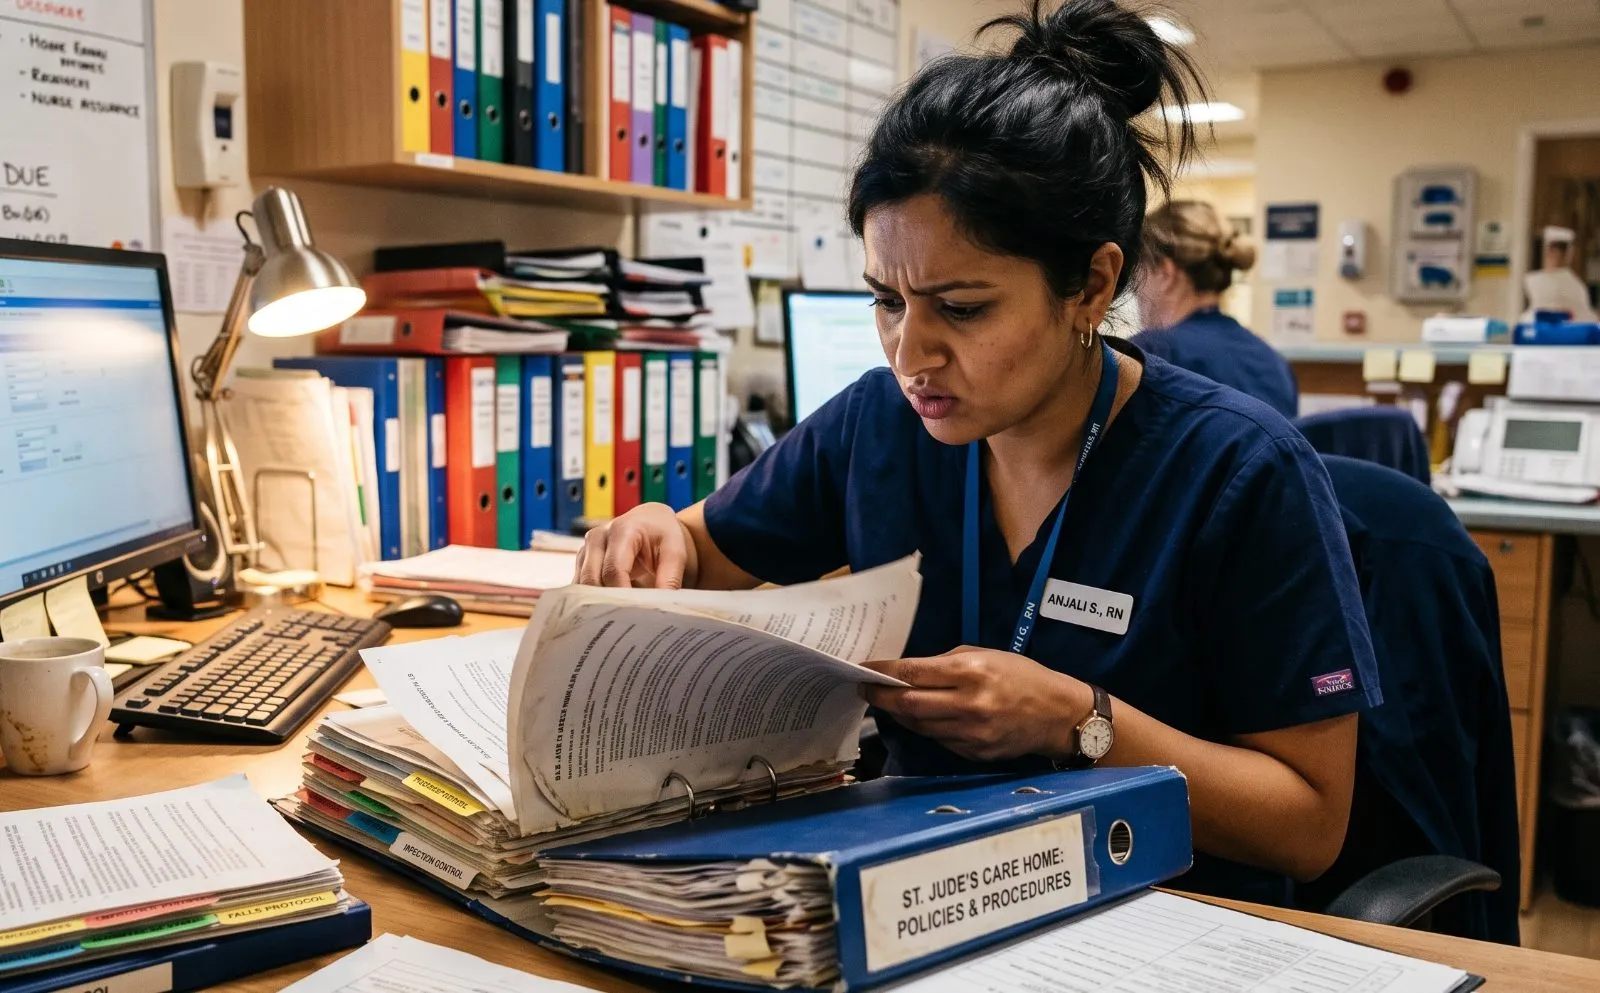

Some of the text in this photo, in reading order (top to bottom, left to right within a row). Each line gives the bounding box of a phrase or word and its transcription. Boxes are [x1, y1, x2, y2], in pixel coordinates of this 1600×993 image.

[3, 161, 51, 187] DUE
[1024, 601, 1036, 620] RN
[1047, 593, 1124, 620] ANJALI S., RN
[434, 859, 463, 879] CONTROL
[902, 847, 1064, 909] ST. JUDE'S CARE HOME:
[228, 896, 326, 919] FALLS PROTOCOL
[897, 870, 1072, 939] POLICIES & PROCEDURES
